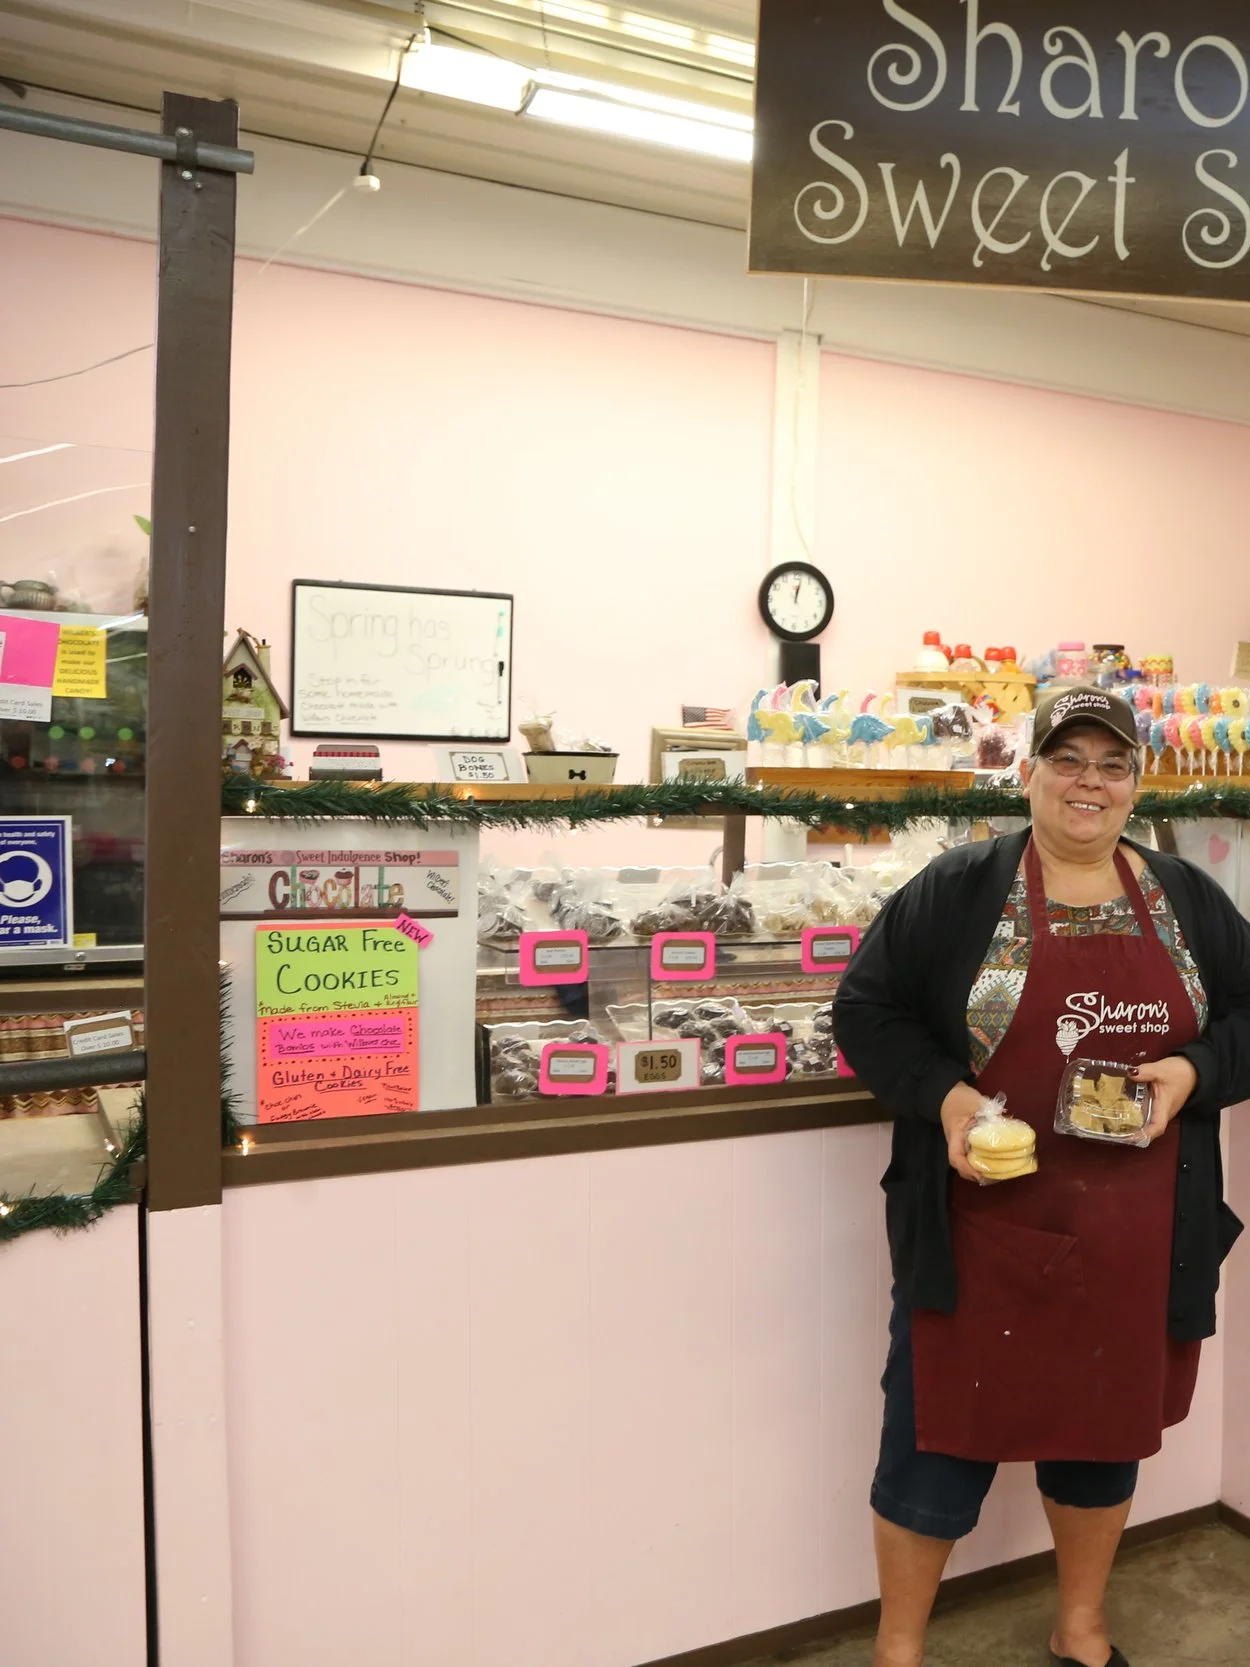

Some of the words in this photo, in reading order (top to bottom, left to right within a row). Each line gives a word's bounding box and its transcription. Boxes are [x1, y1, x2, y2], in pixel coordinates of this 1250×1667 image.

[794, 120, 1135, 271] Sweet
[307, 594, 399, 663] Spring
[408, 605, 452, 641] has
[403, 642, 496, 688] Sprung
[1070, 702, 1092, 710] sweet
[1093, 702, 1110, 710] shop
[462, 756, 485, 764] DOG
[458, 764, 494, 772] BONES
[221, 851, 273, 864] Sharon's
[296, 850, 325, 863] Sweet
[327, 850, 382, 864] Indulgence
[384, 851, 422, 865] Shop!
[0, 915, 42, 925] Please,
[13, 926, 21, 934] a
[24, 924, 58, 934] mask.
[396, 919, 429, 944] NEW
[362, 929, 406, 953] Free
[299, 1002, 329, 1013] from
[333, 1001, 370, 1010] Stevia
[1056, 991, 1170, 1041] Sharon's
[278, 1029, 306, 1041] We
[311, 1026, 345, 1038] make
[351, 1024, 402, 1035] Chocolate
[1098, 1022, 1138, 1034] sweet
[1140, 1022, 1170, 1036] shop
[72, 1036, 92, 1046] Credit
[93, 1034, 108, 1042] Card
[108, 1031, 124, 1039] Sales
[641, 1054, 677, 1070] $1.50
[272, 1071, 324, 1086] Gluten
[342, 1065, 382, 1080] Dairy
[385, 1060, 410, 1075] Free
[644, 1072, 666, 1080] EGGS
[315, 1080, 364, 1092] Cookies
